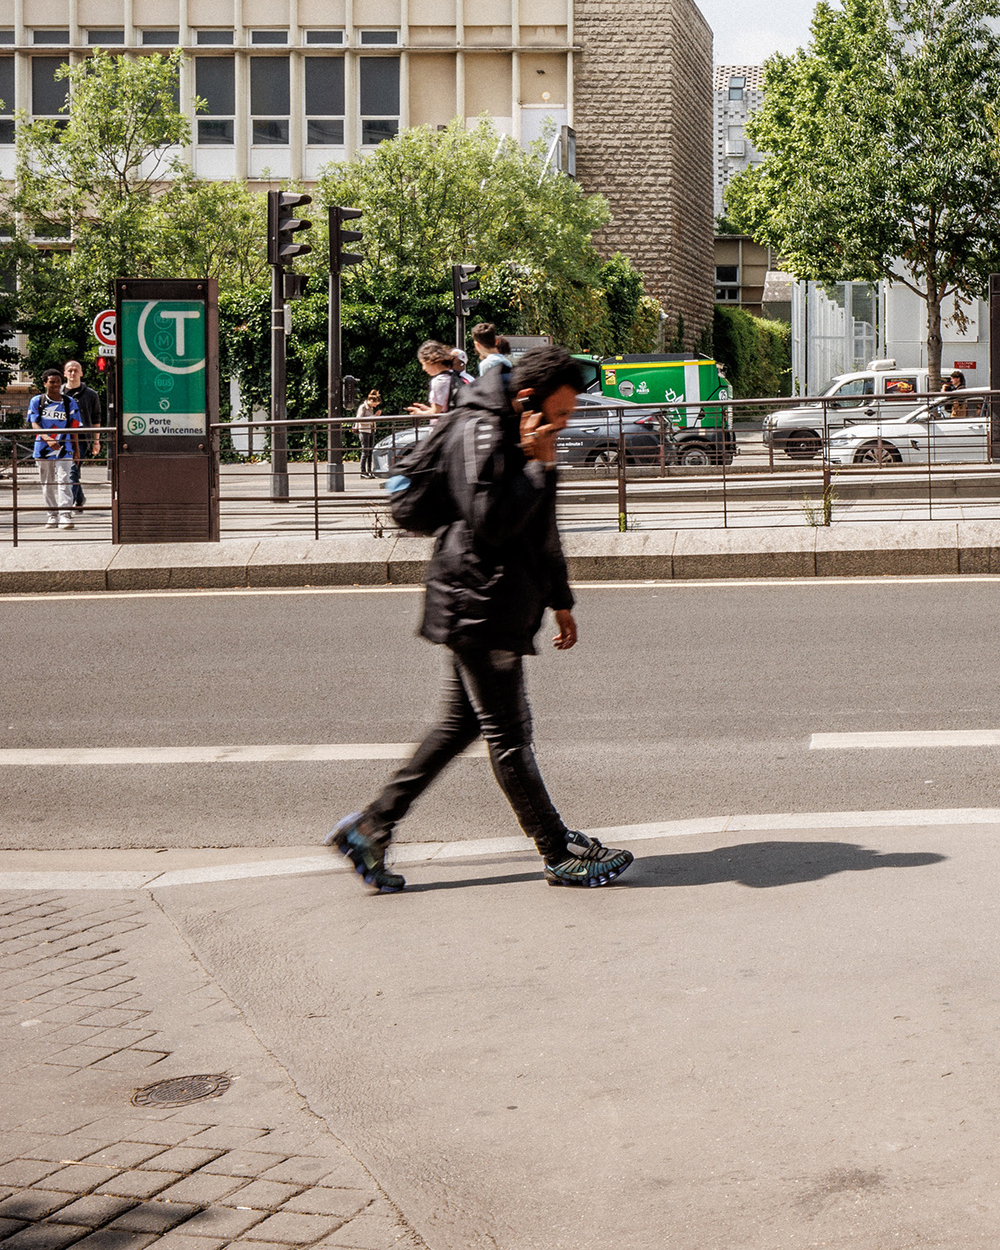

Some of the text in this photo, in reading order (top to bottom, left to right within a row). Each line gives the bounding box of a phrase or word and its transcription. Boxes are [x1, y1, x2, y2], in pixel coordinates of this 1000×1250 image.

[102, 321, 116, 336] 5
[158, 336, 169, 346] M
[157, 378, 172, 386] BUS
[131, 421, 144, 431] 3b
[149, 426, 203, 434] de Vincennes
